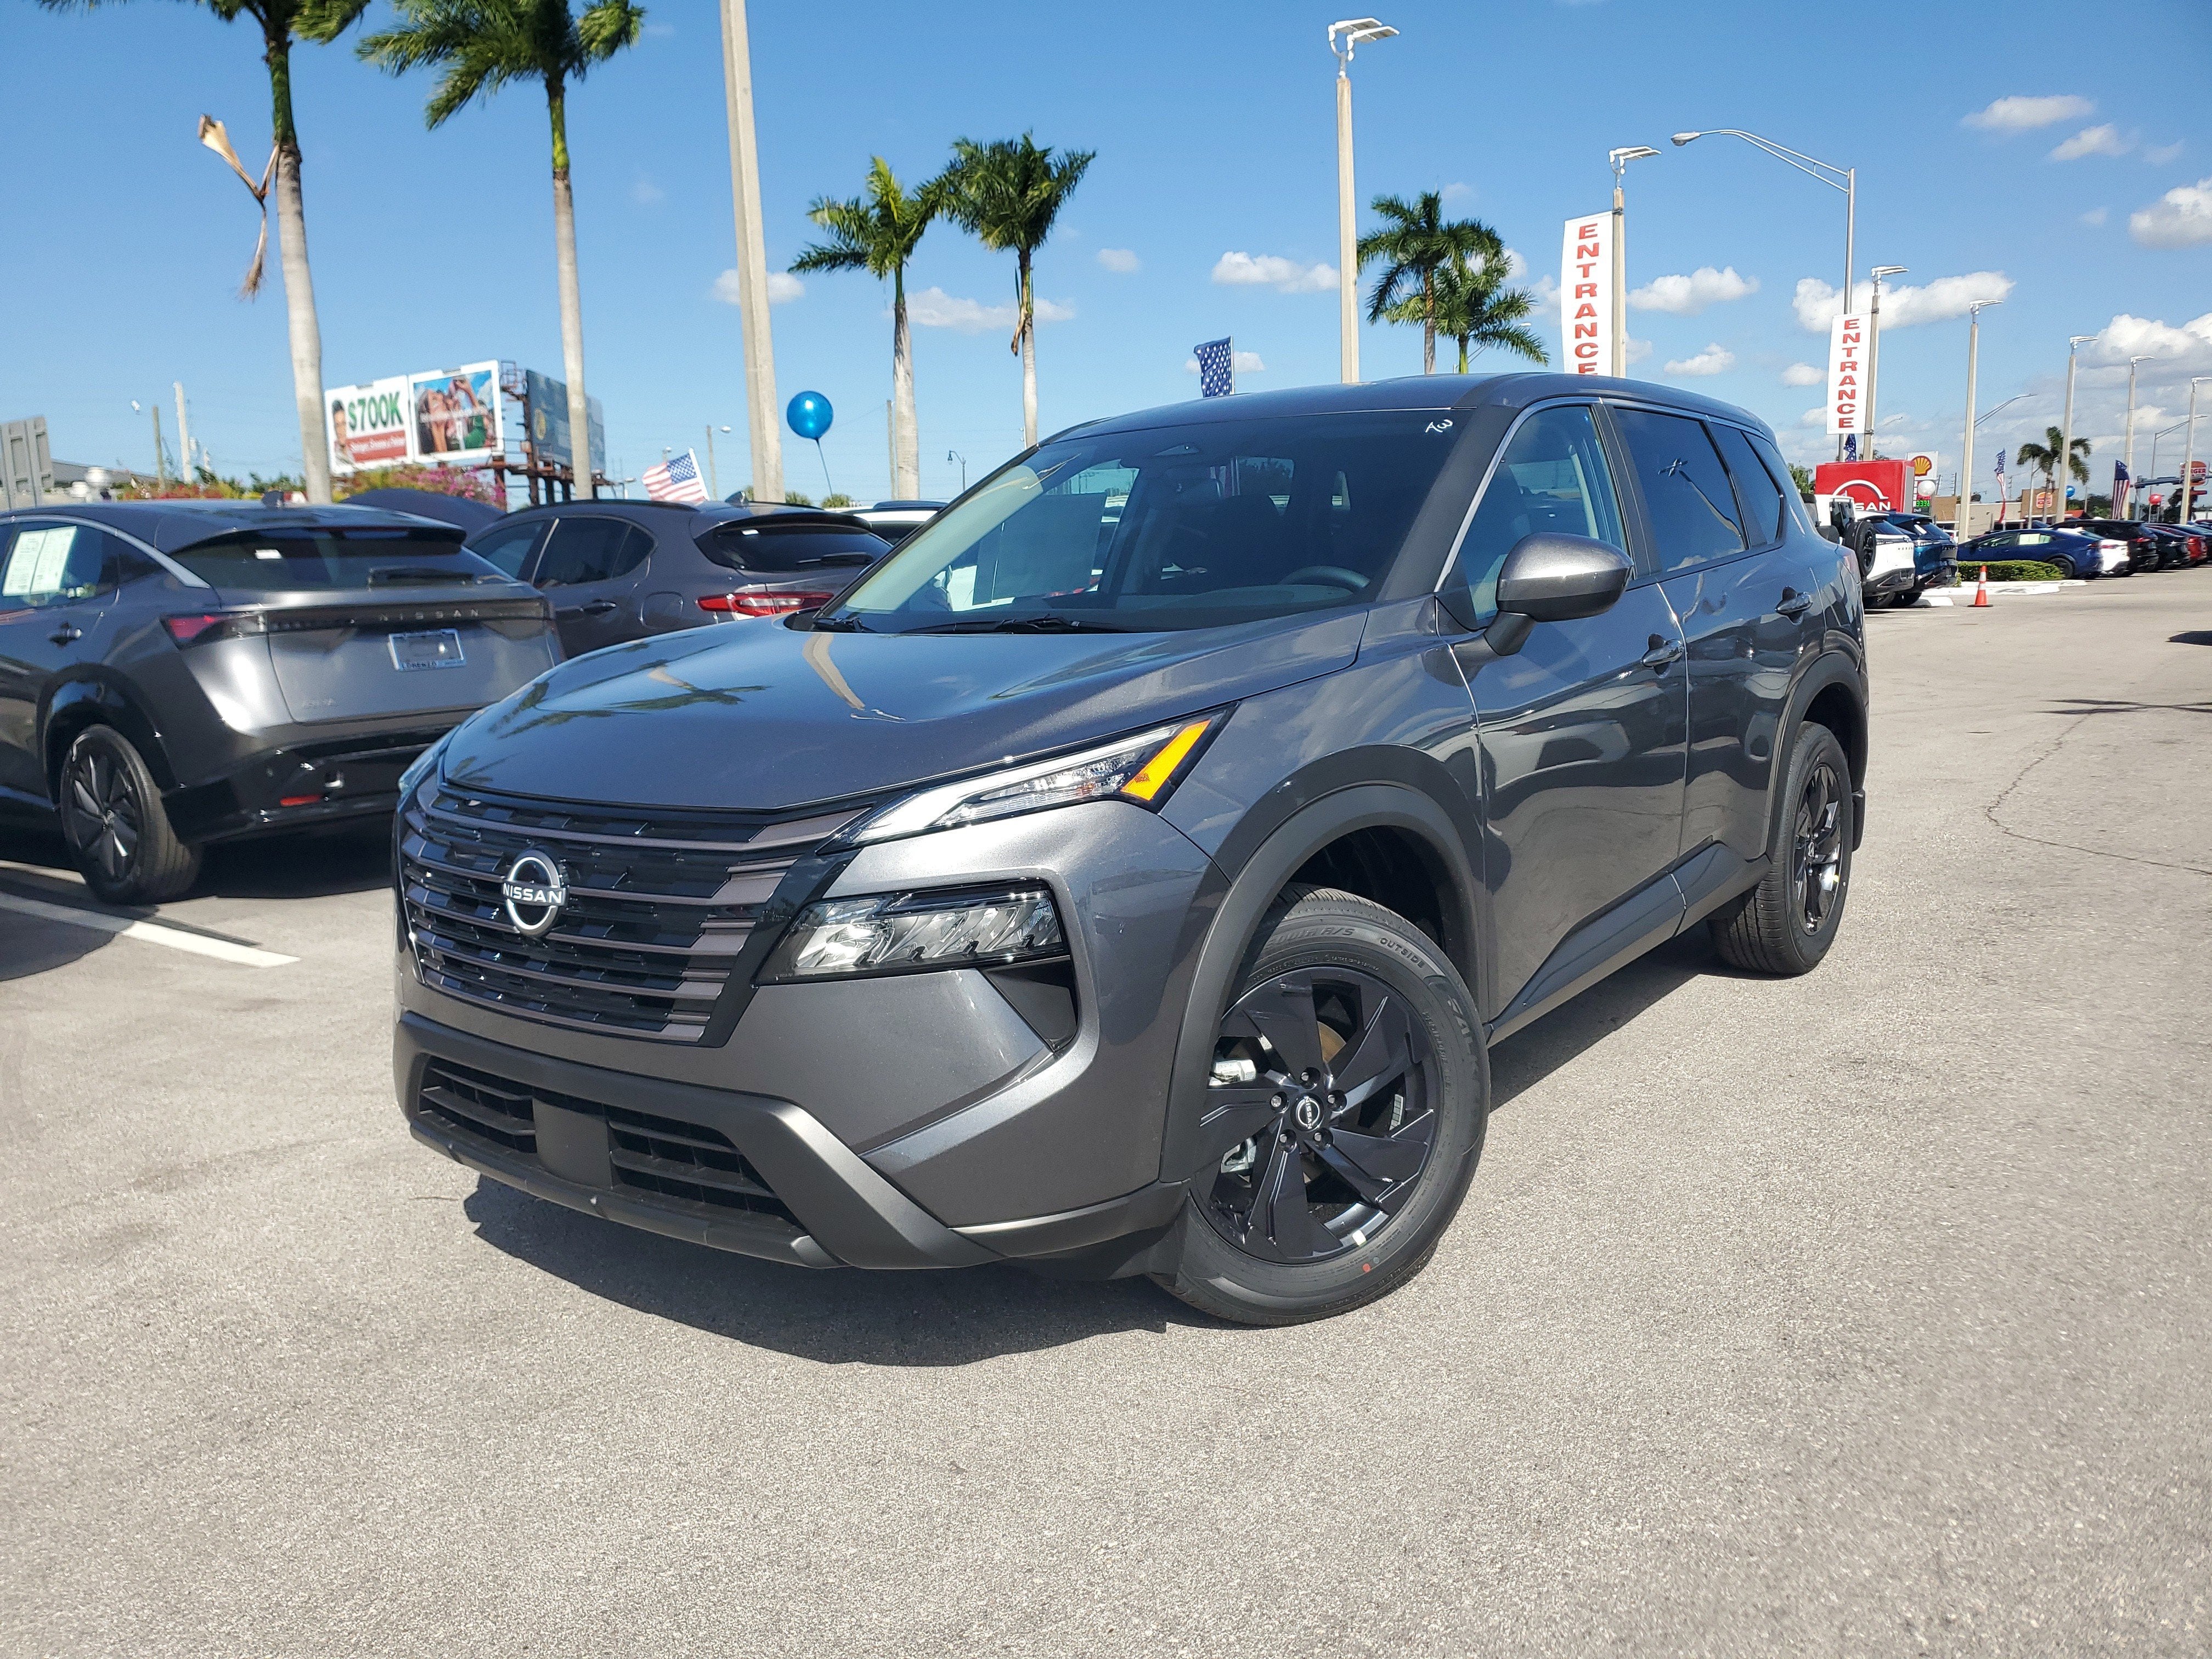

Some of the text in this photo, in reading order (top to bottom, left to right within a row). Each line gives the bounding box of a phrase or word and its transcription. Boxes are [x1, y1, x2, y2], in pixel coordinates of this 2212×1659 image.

[1574, 223, 1599, 375] ENTRANCE
[1837, 318, 1860, 428] ENTRANCE
[1854, 501, 1891, 511] SAN
[503, 883, 562, 904] NISSAN
[1380, 938, 1425, 968] OUTSIDE
[1304, 1096, 1312, 1129] NISSAN
